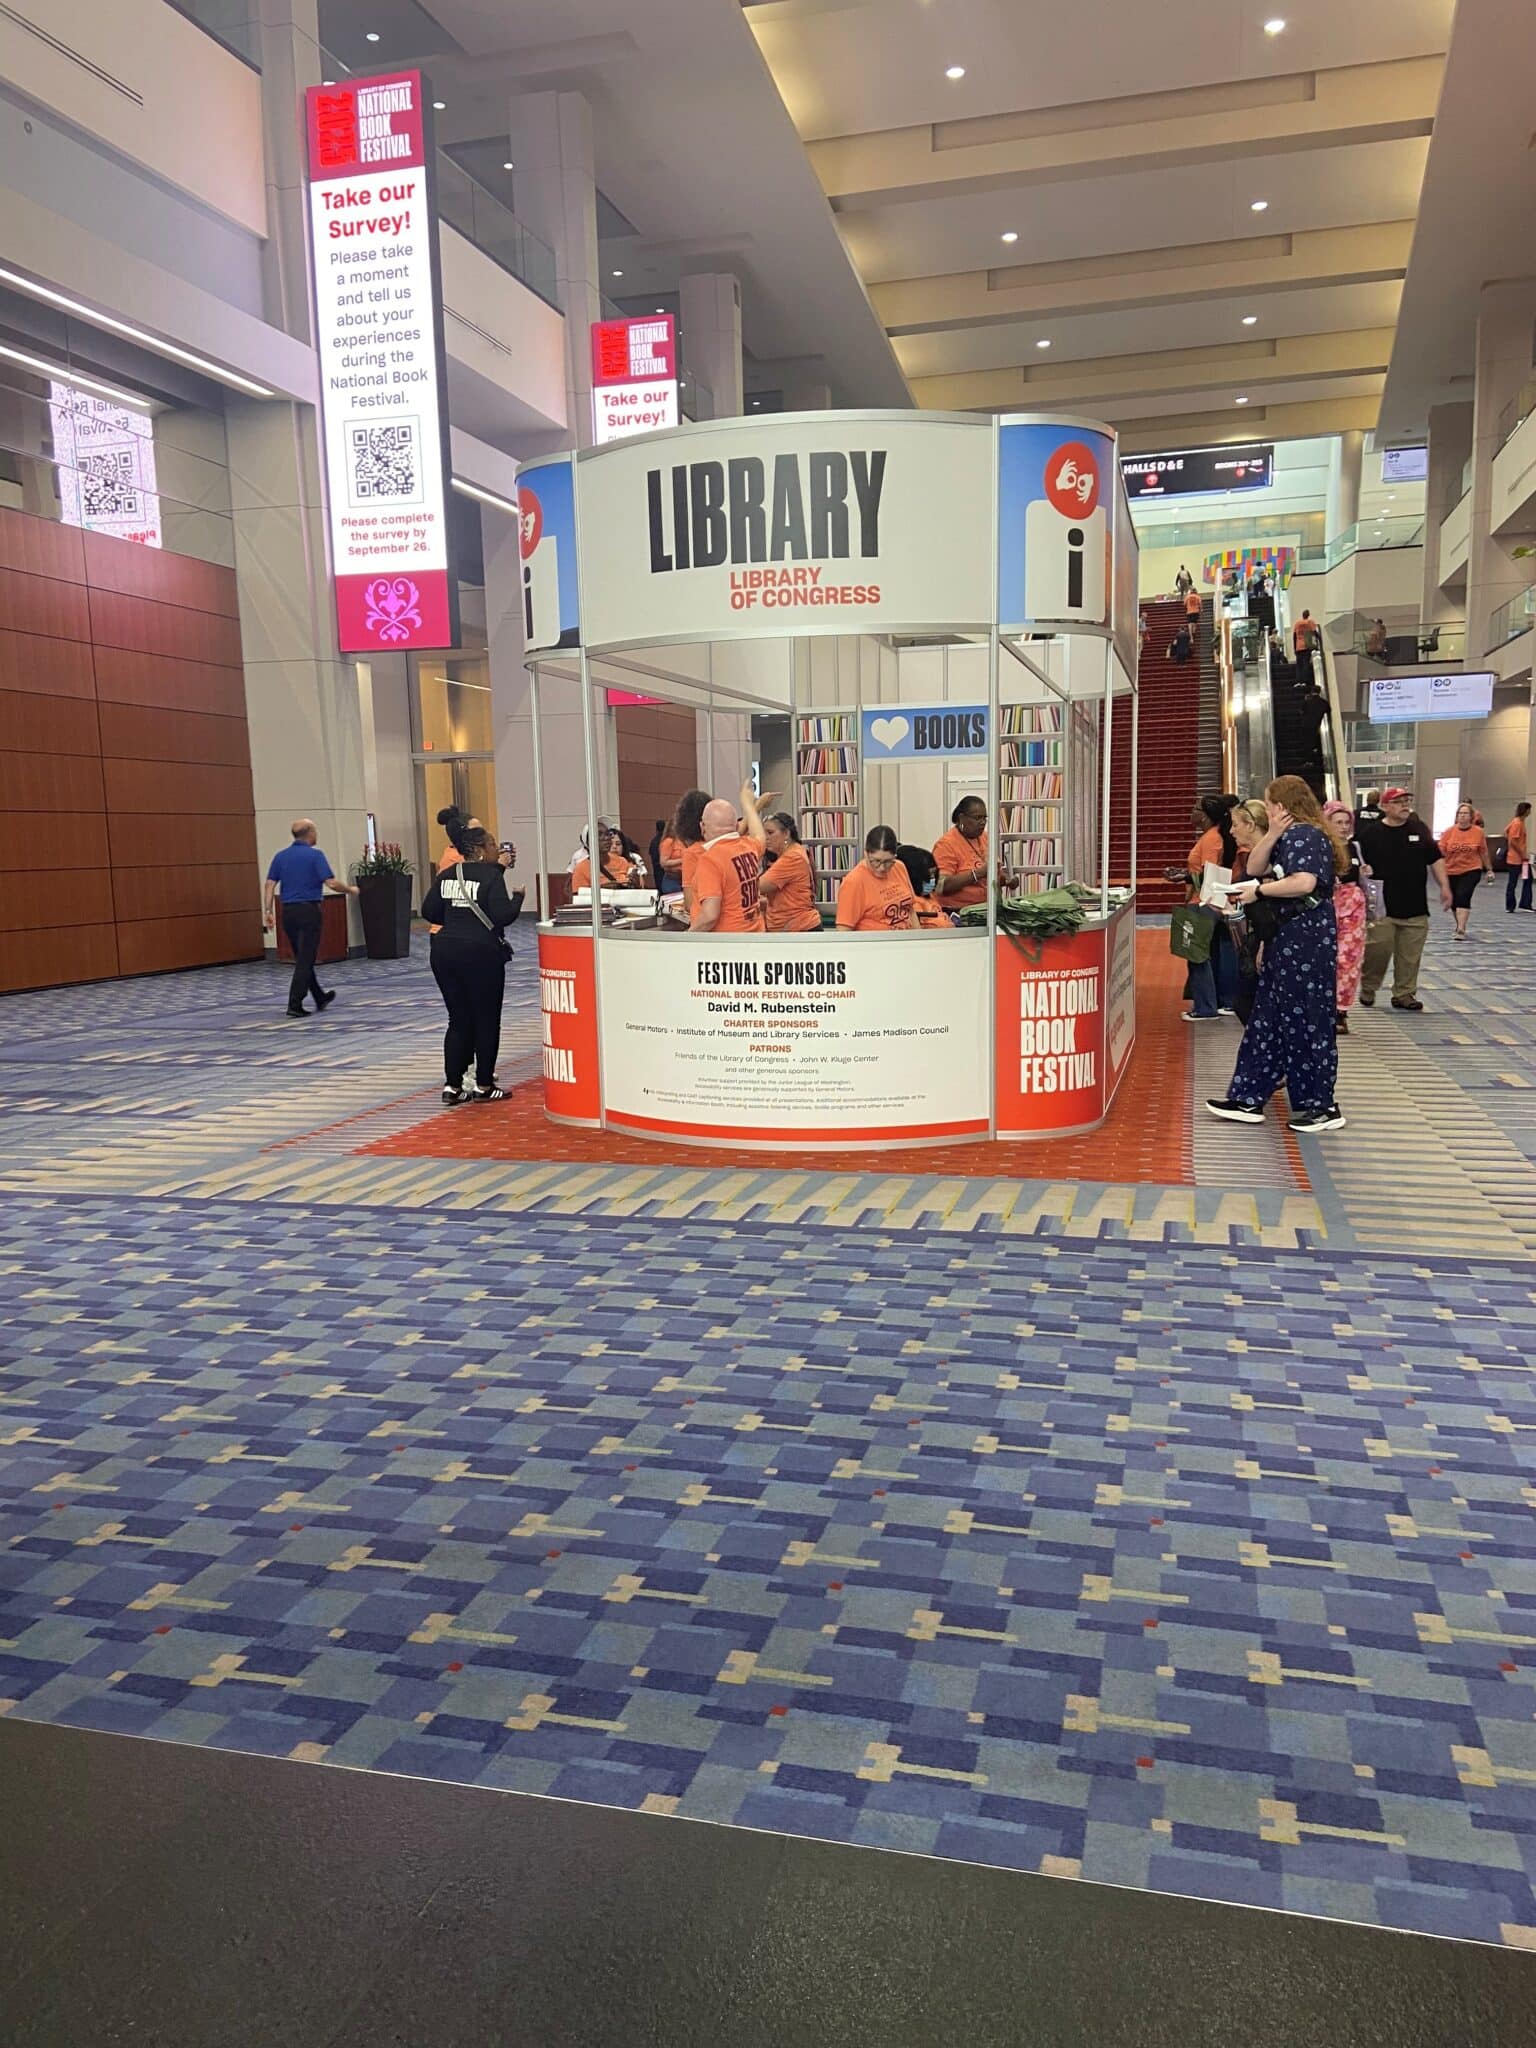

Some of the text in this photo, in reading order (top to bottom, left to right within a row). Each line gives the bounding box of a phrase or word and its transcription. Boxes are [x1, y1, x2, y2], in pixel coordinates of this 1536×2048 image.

[358, 88, 413, 117] NATIONAL
[359, 114, 392, 140] BOOK
[360, 134, 412, 163] FESTIVAL
[322, 184, 415, 210] Take our
[329, 211, 410, 238] Survey!
[330, 244, 413, 264] Please take
[337, 266, 409, 285] a moment
[338, 288, 412, 306] and tell us
[337, 309, 414, 326] about your
[333, 329, 420, 348] experiences
[629, 325, 669, 344] NATIONAL
[342, 351, 414, 368] during the
[630, 343, 654, 360] BOOK
[631, 357, 668, 376] FESTIVAL
[330, 368, 428, 390] National Book
[352, 391, 409, 408] Festival.
[603, 392, 668, 407] Take our
[608, 410, 665, 426] Survey!
[1124, 460, 1184, 474] HALLS D & E
[342, 513, 434, 527] Please complete
[648, 451, 887, 572] LIBRARY
[351, 528, 426, 541] the survey by
[348, 542, 430, 556] September 26.
[1068, 528, 1084, 608] i
[730, 567, 822, 590] LIBRARY
[731, 585, 881, 610] OF CONGRESS
[914, 713, 985, 750] BOOKS
[698, 962, 846, 985] FESTIVAL SPONSORS
[1021, 966, 1100, 980] LIBRARY OF CONGRESS
[690, 990, 856, 999] NATIONAL BOOK FESTIVAL CO-CHAIR
[1020, 977, 1098, 1018] NATIONAL
[708, 1002, 836, 1013] David M. Rubenstein
[626, 1022, 949, 1040] General Motors Institute of Museum and Library Services James Madison Council
[724, 1020, 818, 1028] CHARTER SPONSORS
[1020, 1018, 1077, 1056] BOOK
[750, 1044, 792, 1052] PATRONS
[675, 1052, 698, 1060] Friends
[720, 1055, 744, 1063] Library
[755, 1056, 789, 1064] Congress
[831, 1056, 852, 1064] Kluge
[1020, 1051, 1096, 1094] FESTIVAL
